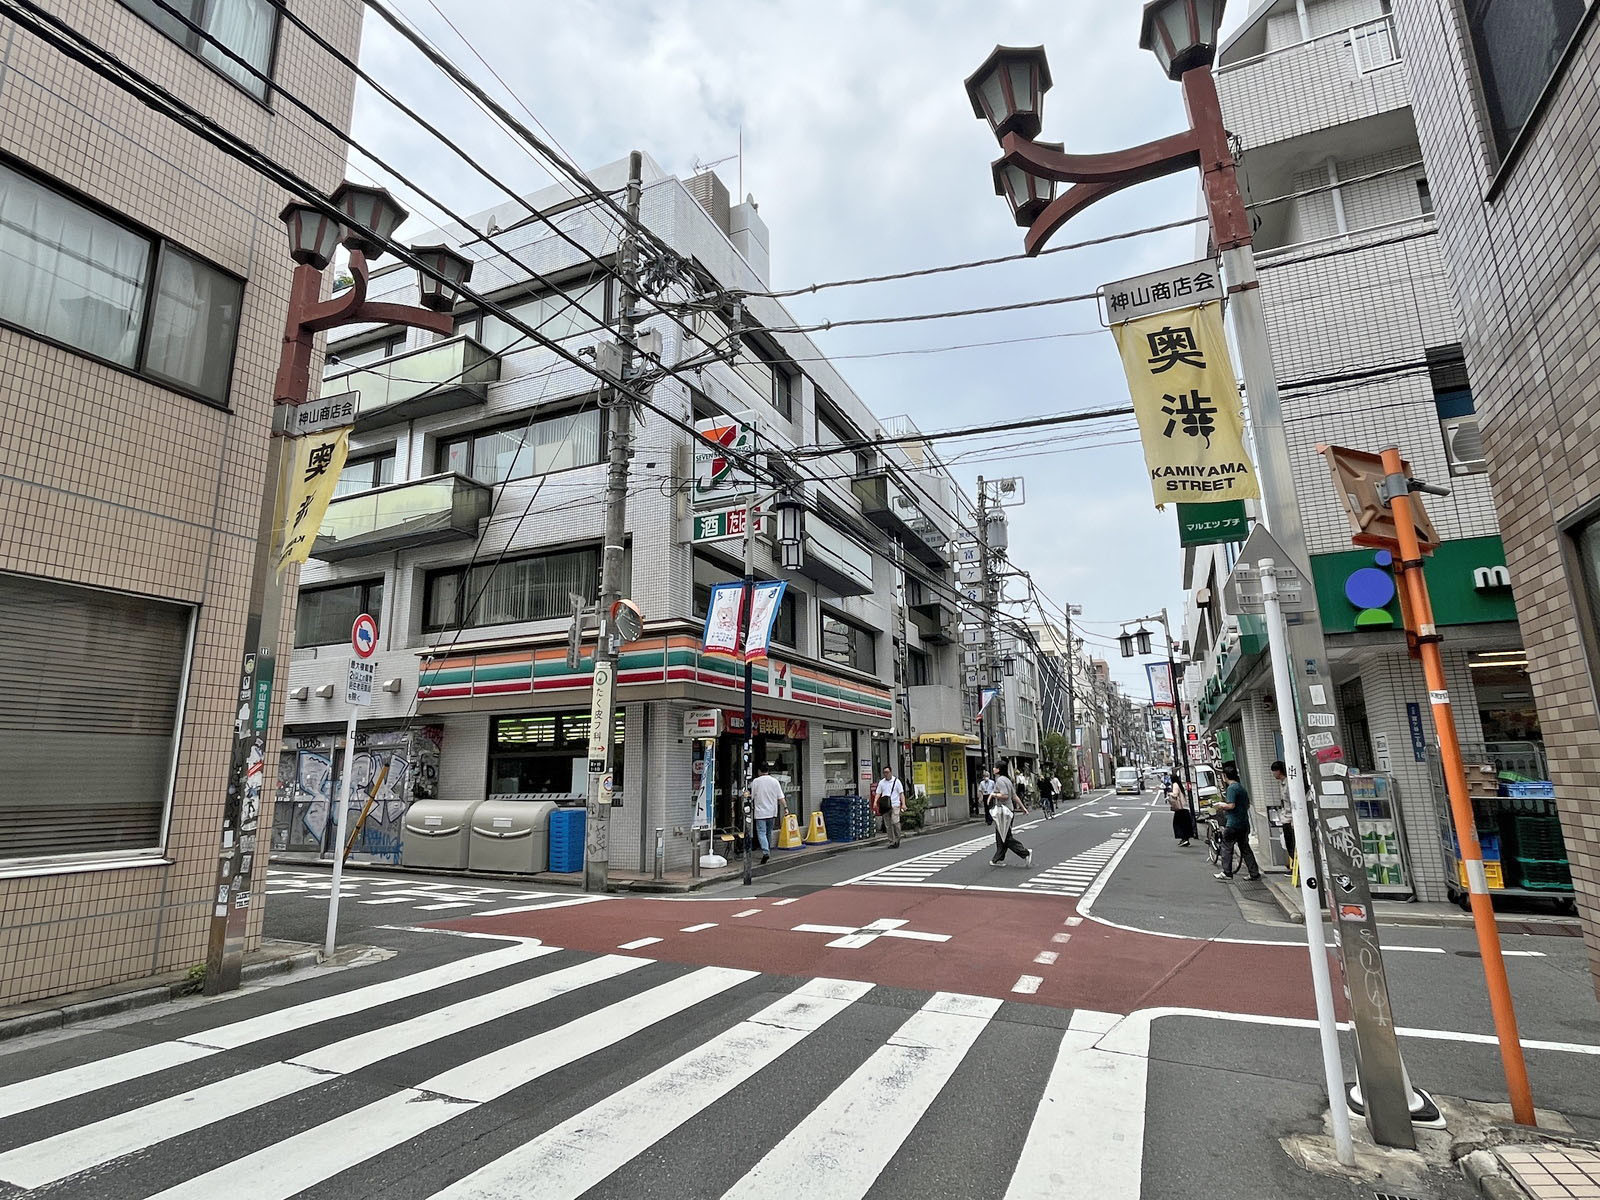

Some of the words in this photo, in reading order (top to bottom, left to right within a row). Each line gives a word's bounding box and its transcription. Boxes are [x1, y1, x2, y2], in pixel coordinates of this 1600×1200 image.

[1110, 272, 1215, 312] 神山商店会
[298, 402, 353, 425] 神山商店会
[1152, 462, 1248, 479] KAMIYAMA
[1166, 477, 1236, 491] STREET
[701, 515, 719, 539] 酒
[593, 688, 603, 742] たく皮フ科
